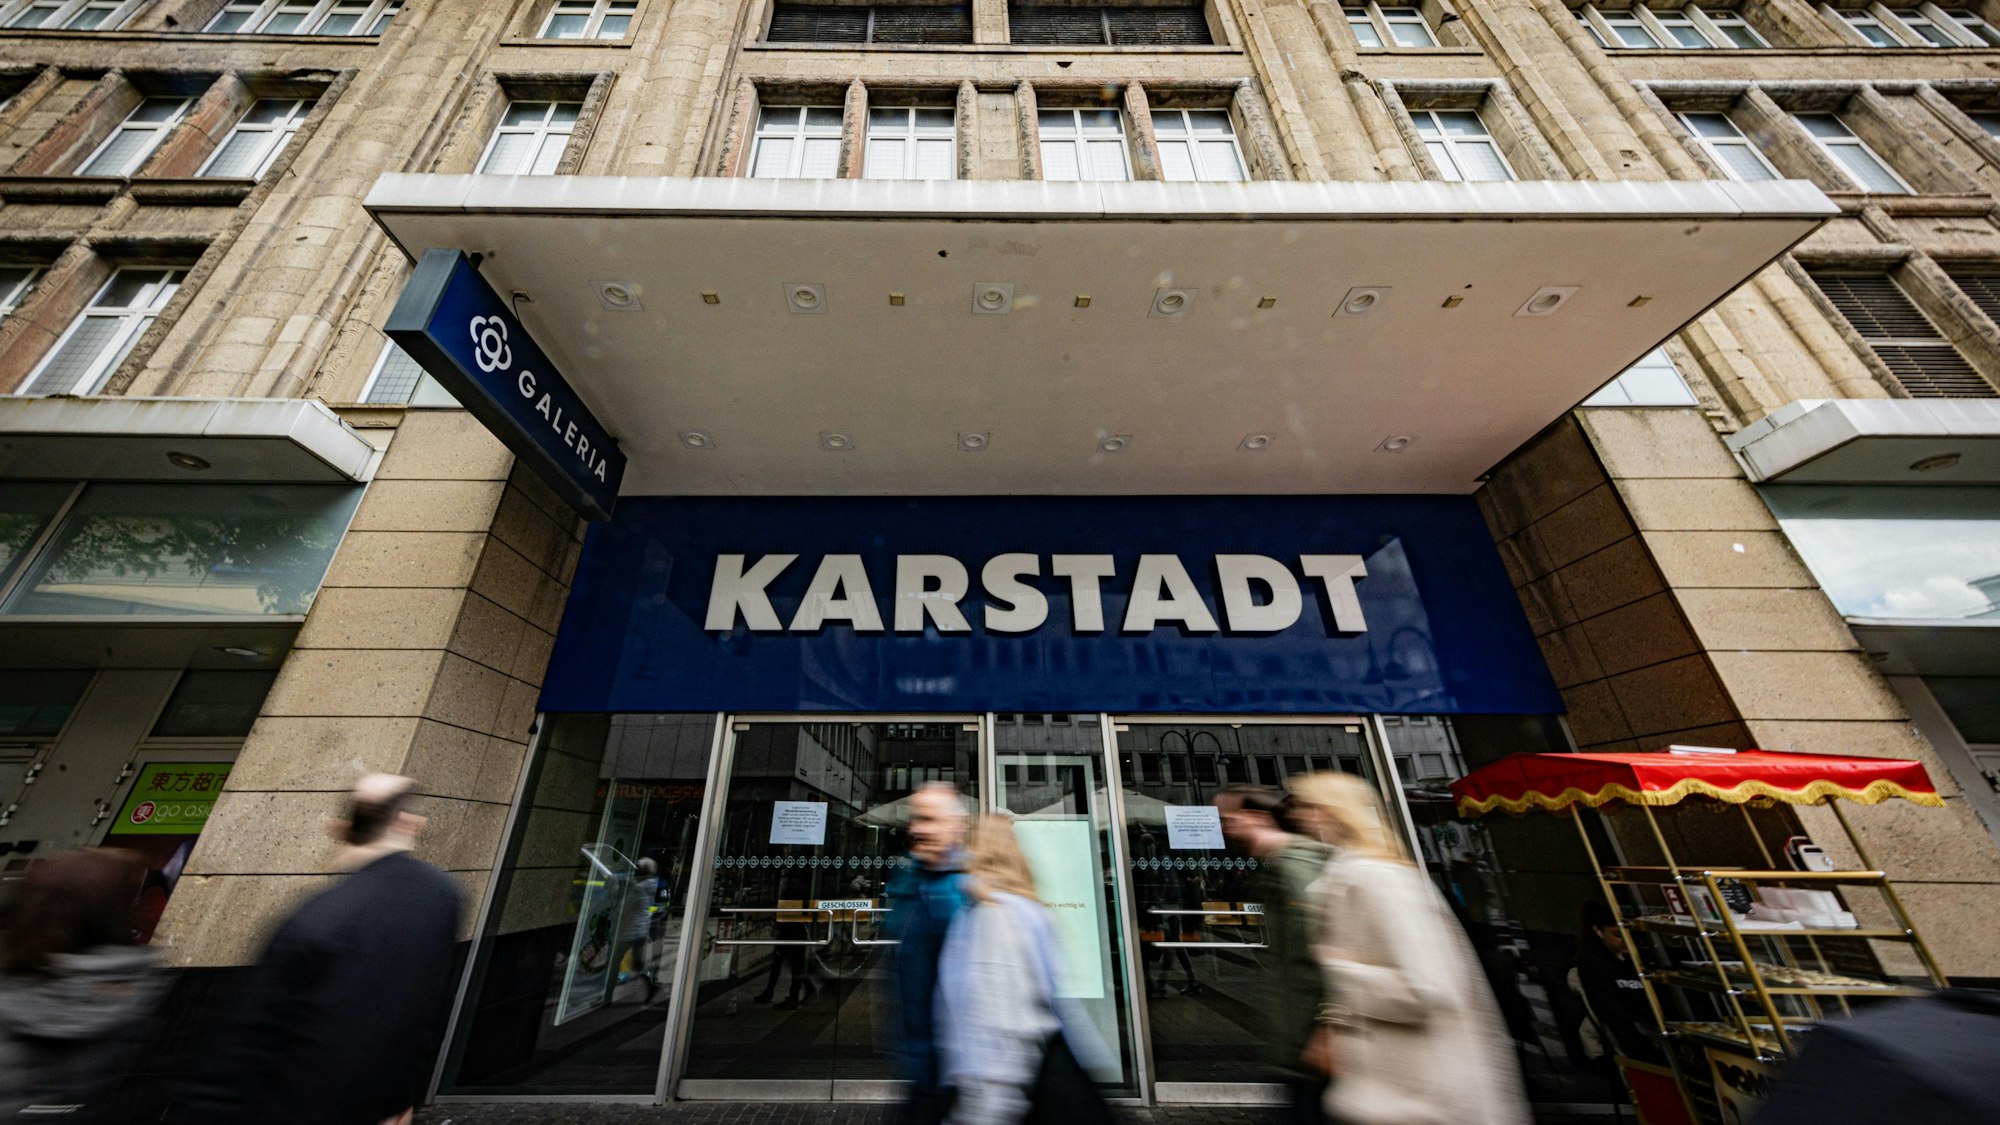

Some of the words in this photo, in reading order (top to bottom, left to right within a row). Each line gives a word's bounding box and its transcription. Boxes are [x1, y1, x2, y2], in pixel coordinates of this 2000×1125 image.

[518, 369, 607, 483] GALERIA
[704, 553, 1368, 633] KARSTADT
[154, 805, 181, 823] go
[821, 901, 869, 909] GESCHLOSSEN
[1058, 901, 1077, 909] wichtig
